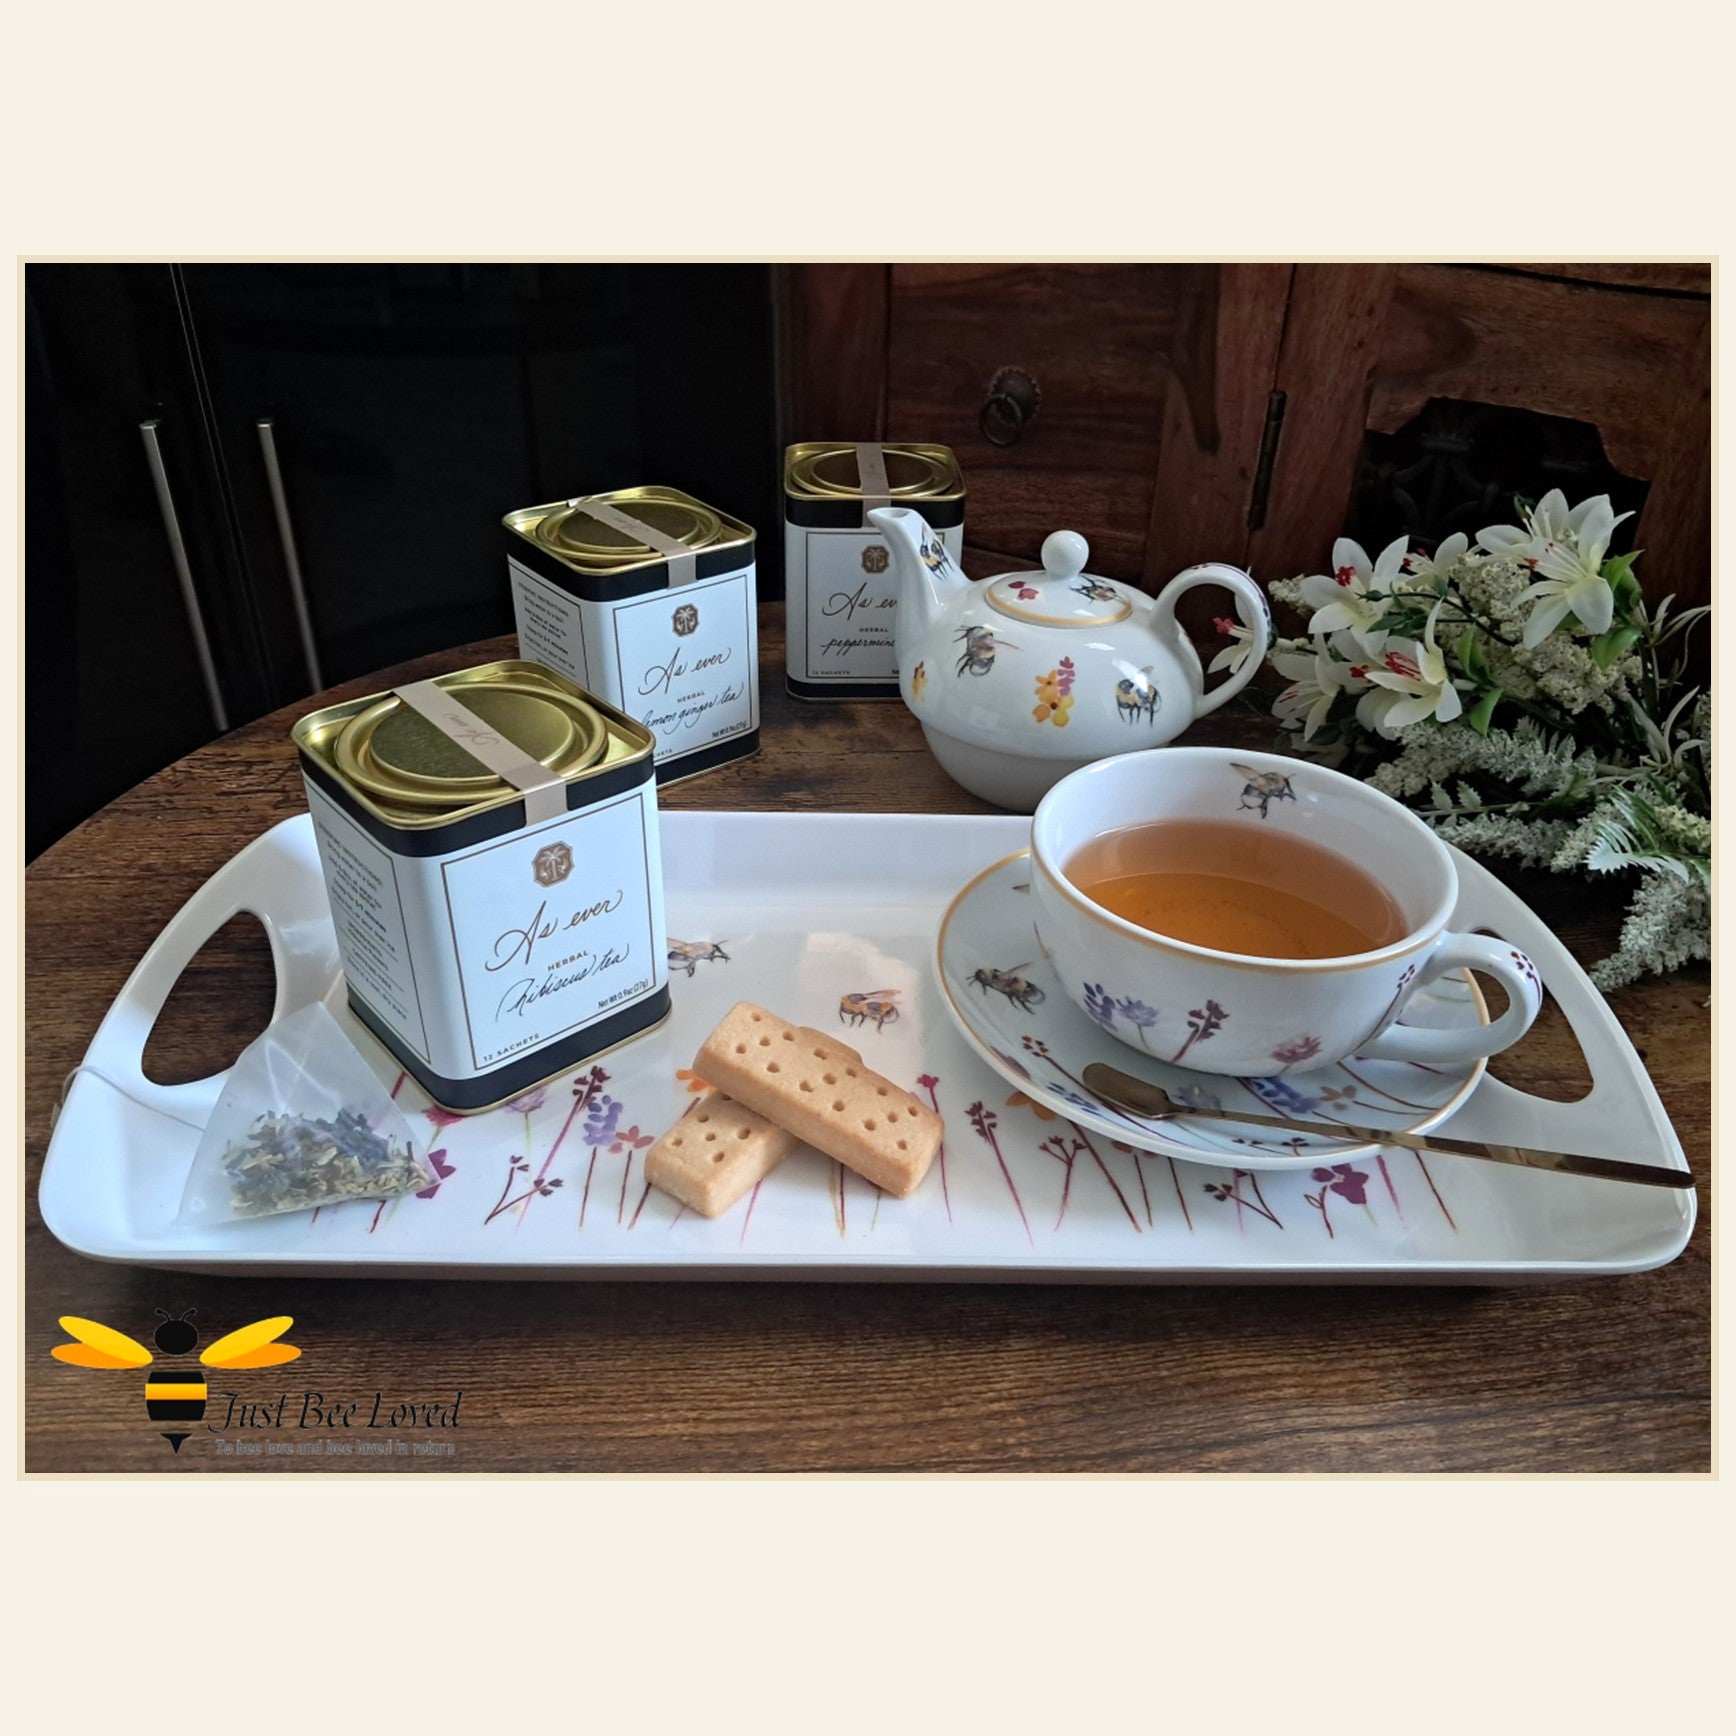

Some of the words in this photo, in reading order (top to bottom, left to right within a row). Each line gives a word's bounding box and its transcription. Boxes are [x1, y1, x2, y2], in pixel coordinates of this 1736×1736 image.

[822, 582, 873, 621] As
[876, 597, 898, 609] ev
[820, 637, 896, 656] peppermin
[638, 647, 688, 696] As
[691, 647, 732, 672] ever
[662, 695, 718, 735] ginger
[717, 682, 744, 705] tea
[677, 690, 706, 703] HERBAL
[484, 900, 558, 973] As
[563, 889, 624, 931] ever
[548, 950, 589, 972] HERBAL
[592, 943, 630, 976] tea
[598, 999, 609, 1009] Net
[483, 1055, 494, 1063] 12
[497, 1033, 540, 1055] SACHETS
